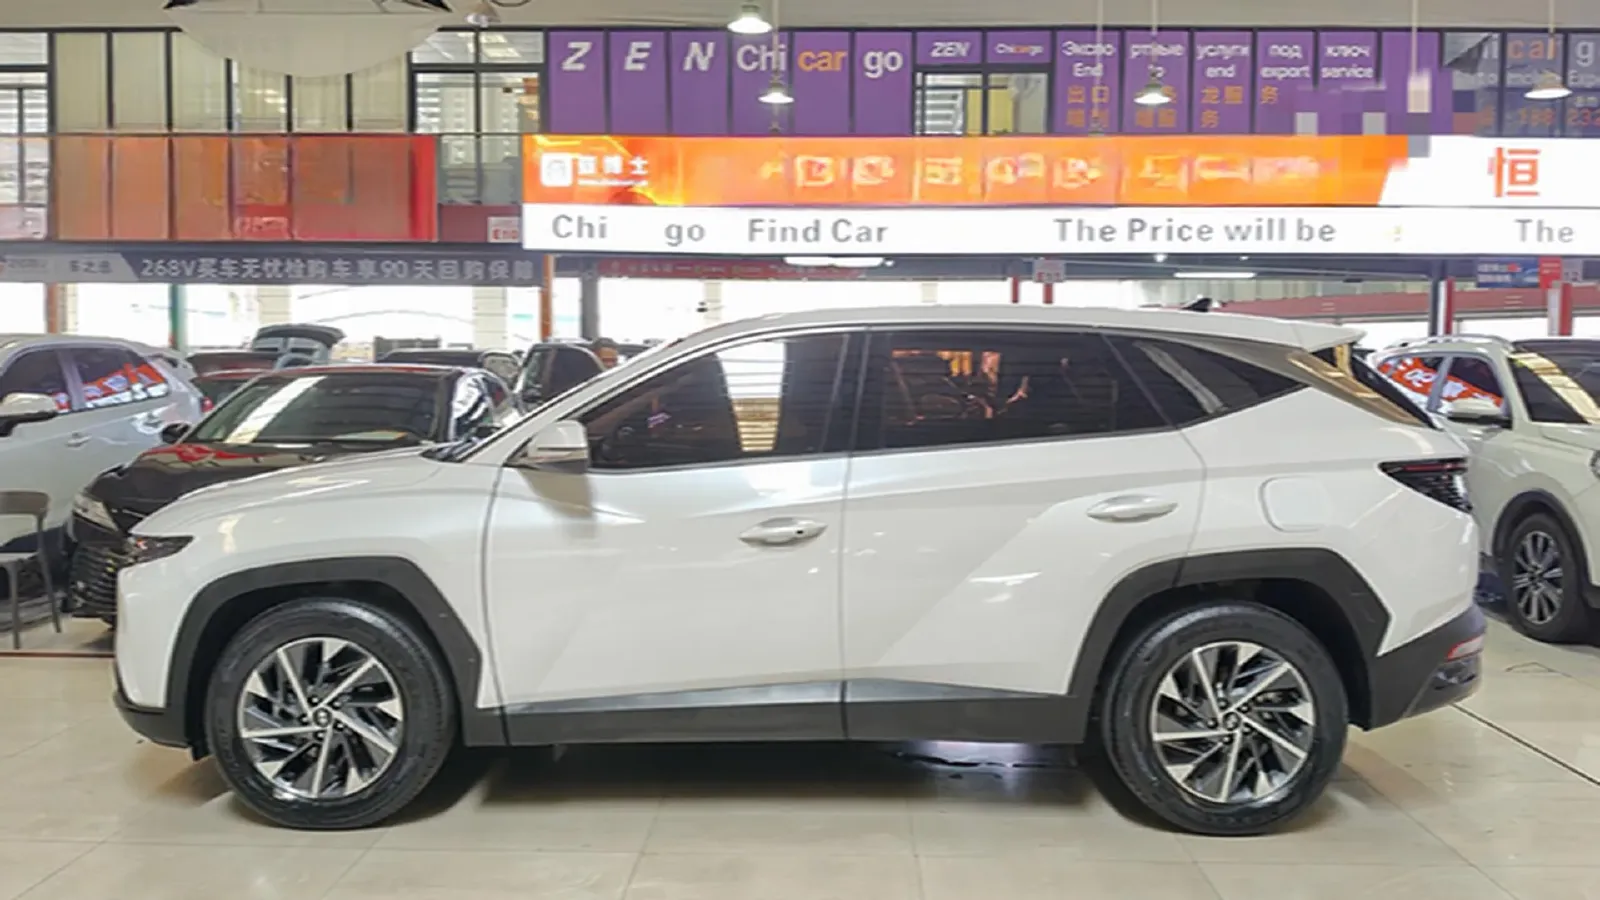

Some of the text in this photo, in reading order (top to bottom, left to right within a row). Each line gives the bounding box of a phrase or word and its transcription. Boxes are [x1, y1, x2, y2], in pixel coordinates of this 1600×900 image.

[863, 50, 904, 79] go
[551, 214, 1575, 247] Chi go Find Car The Price will be The
